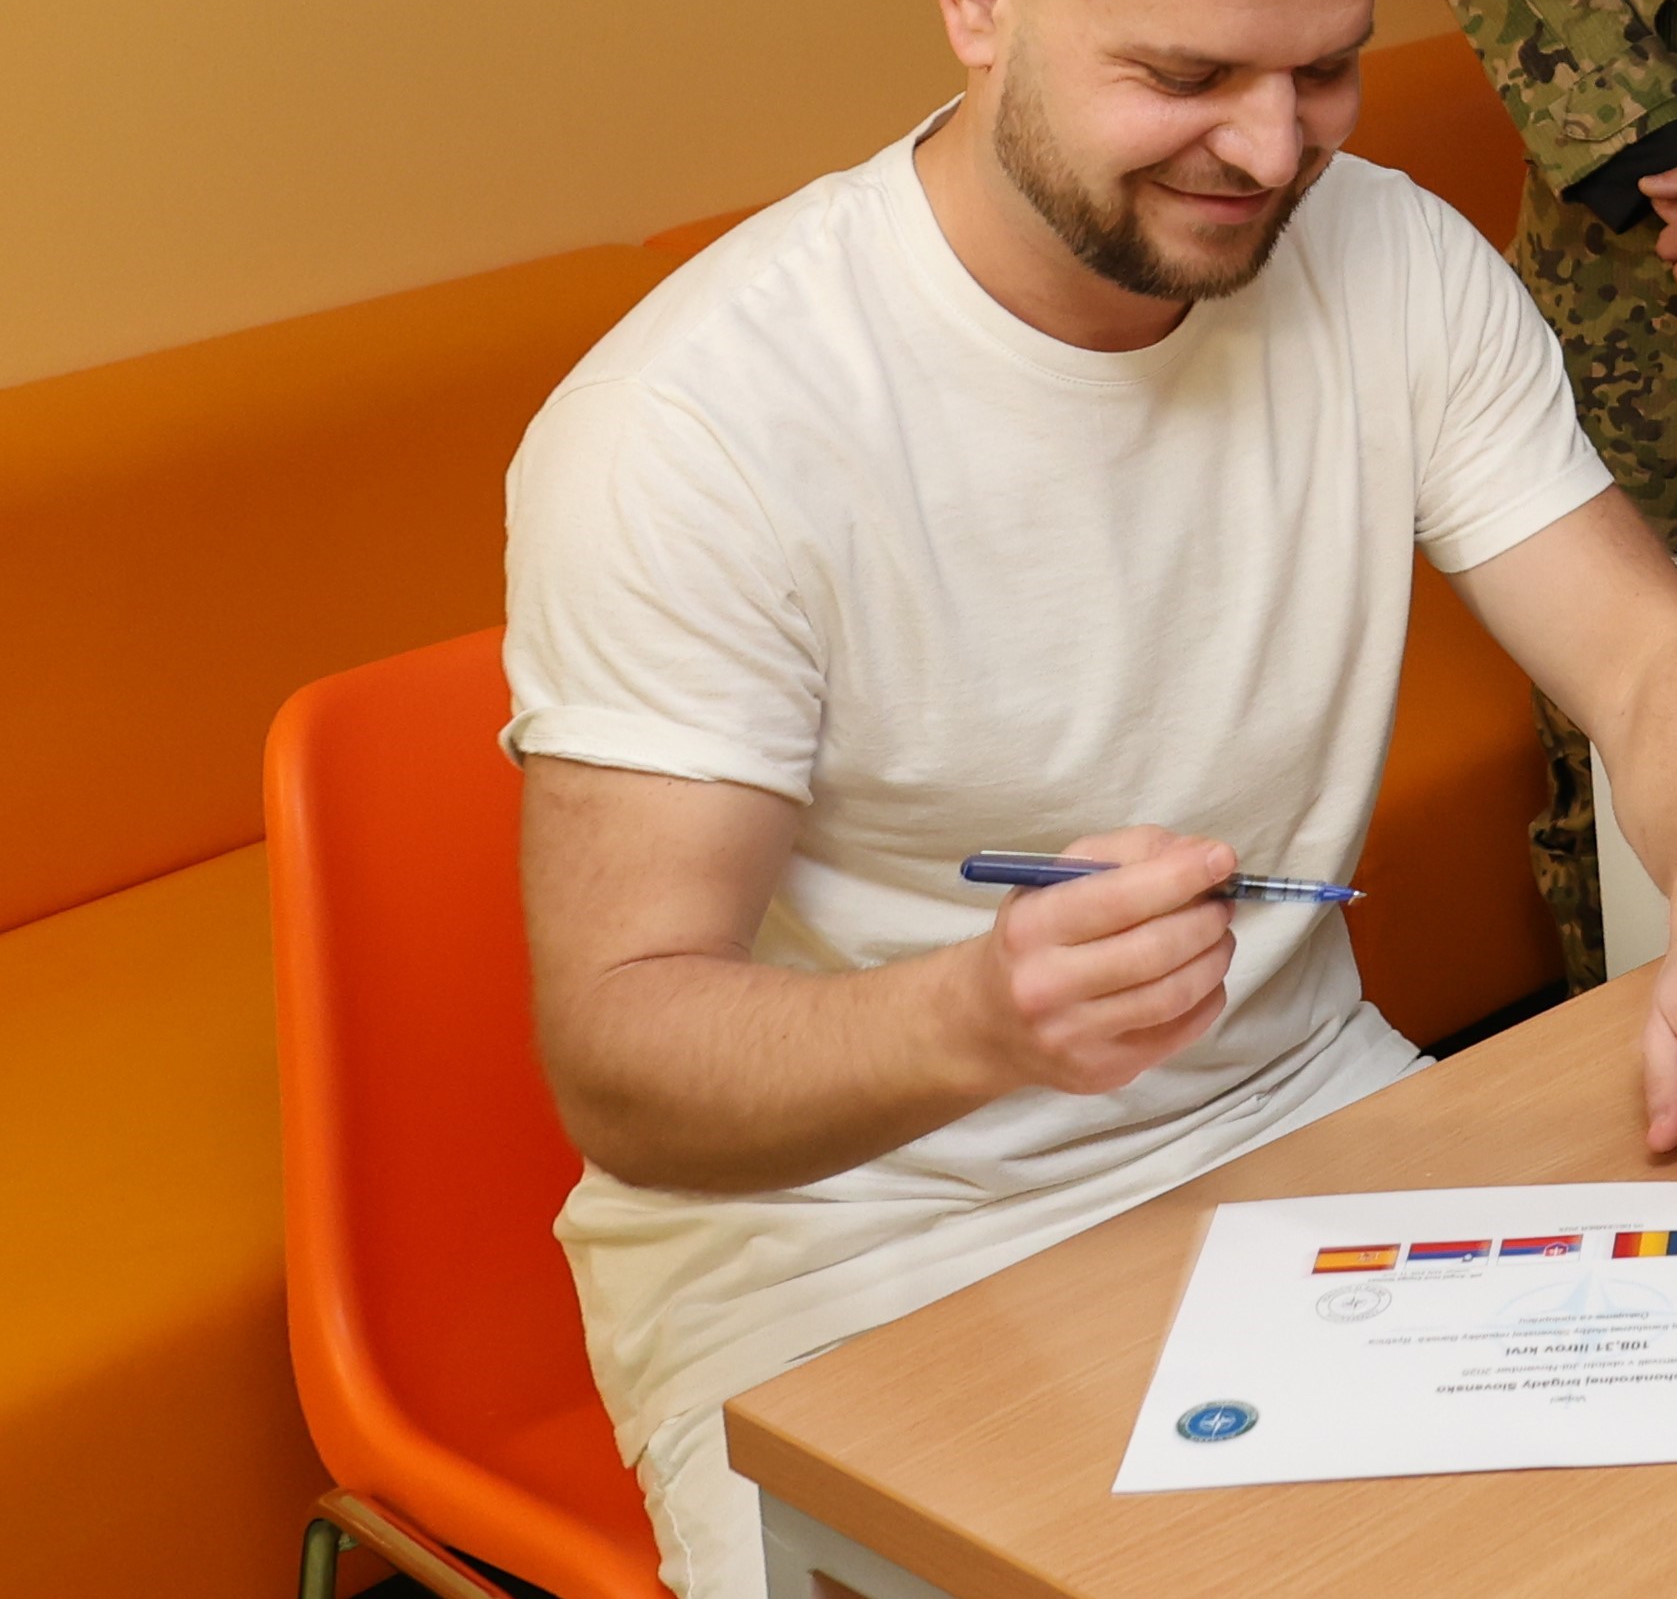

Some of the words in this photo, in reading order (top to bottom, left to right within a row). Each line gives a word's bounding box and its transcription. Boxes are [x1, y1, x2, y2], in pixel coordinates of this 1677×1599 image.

[1506, 1346, 1538, 1355] krvi
[1544, 1344, 1588, 1352] litrov
[1436, 1383, 1516, 1393] Slovensko
